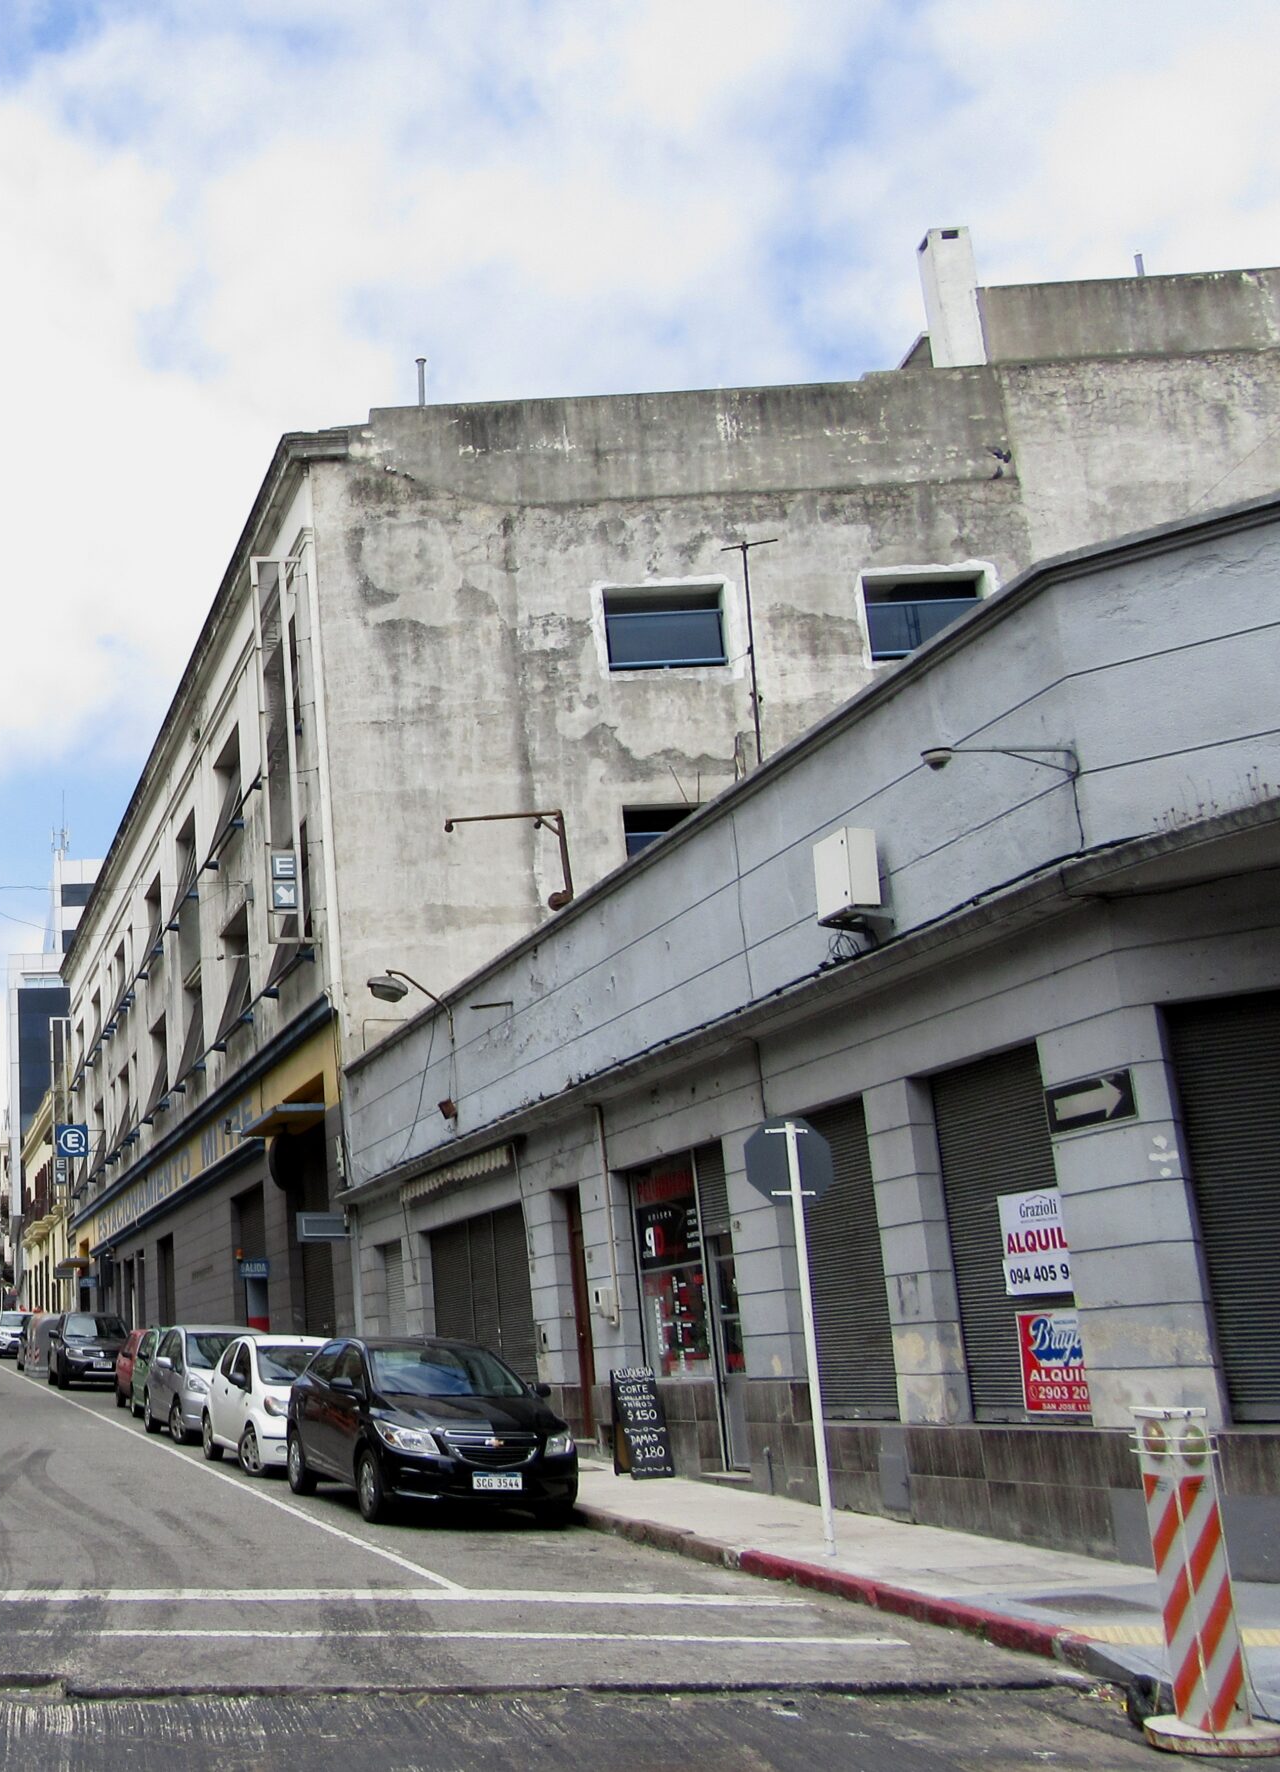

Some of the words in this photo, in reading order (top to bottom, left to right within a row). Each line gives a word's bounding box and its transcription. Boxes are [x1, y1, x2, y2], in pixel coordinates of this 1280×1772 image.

[276, 858, 293, 874] E
[67, 1134, 80, 1147] E
[57, 1160, 65, 1168] E
[1019, 1199, 1058, 1218] Grazioli
[648, 1210, 672, 1222] unisex
[1007, 1226, 1069, 1254] ALQUIL
[1010, 1268, 1031, 1284] 094
[1034, 1264, 1057, 1281] 405
[1060, 1263, 1070, 1280] 9
[1030, 1369, 1087, 1382] ALQUIL
[619, 1384, 648, 1394] CORTE
[1038, 1386, 1069, 1400] 2903
[1072, 1385, 1088, 1400] 20
[1041, 1402, 1057, 1410] SAN
[631, 1434, 659, 1446] DAMAS
[497, 1478, 520, 1488] 3544
